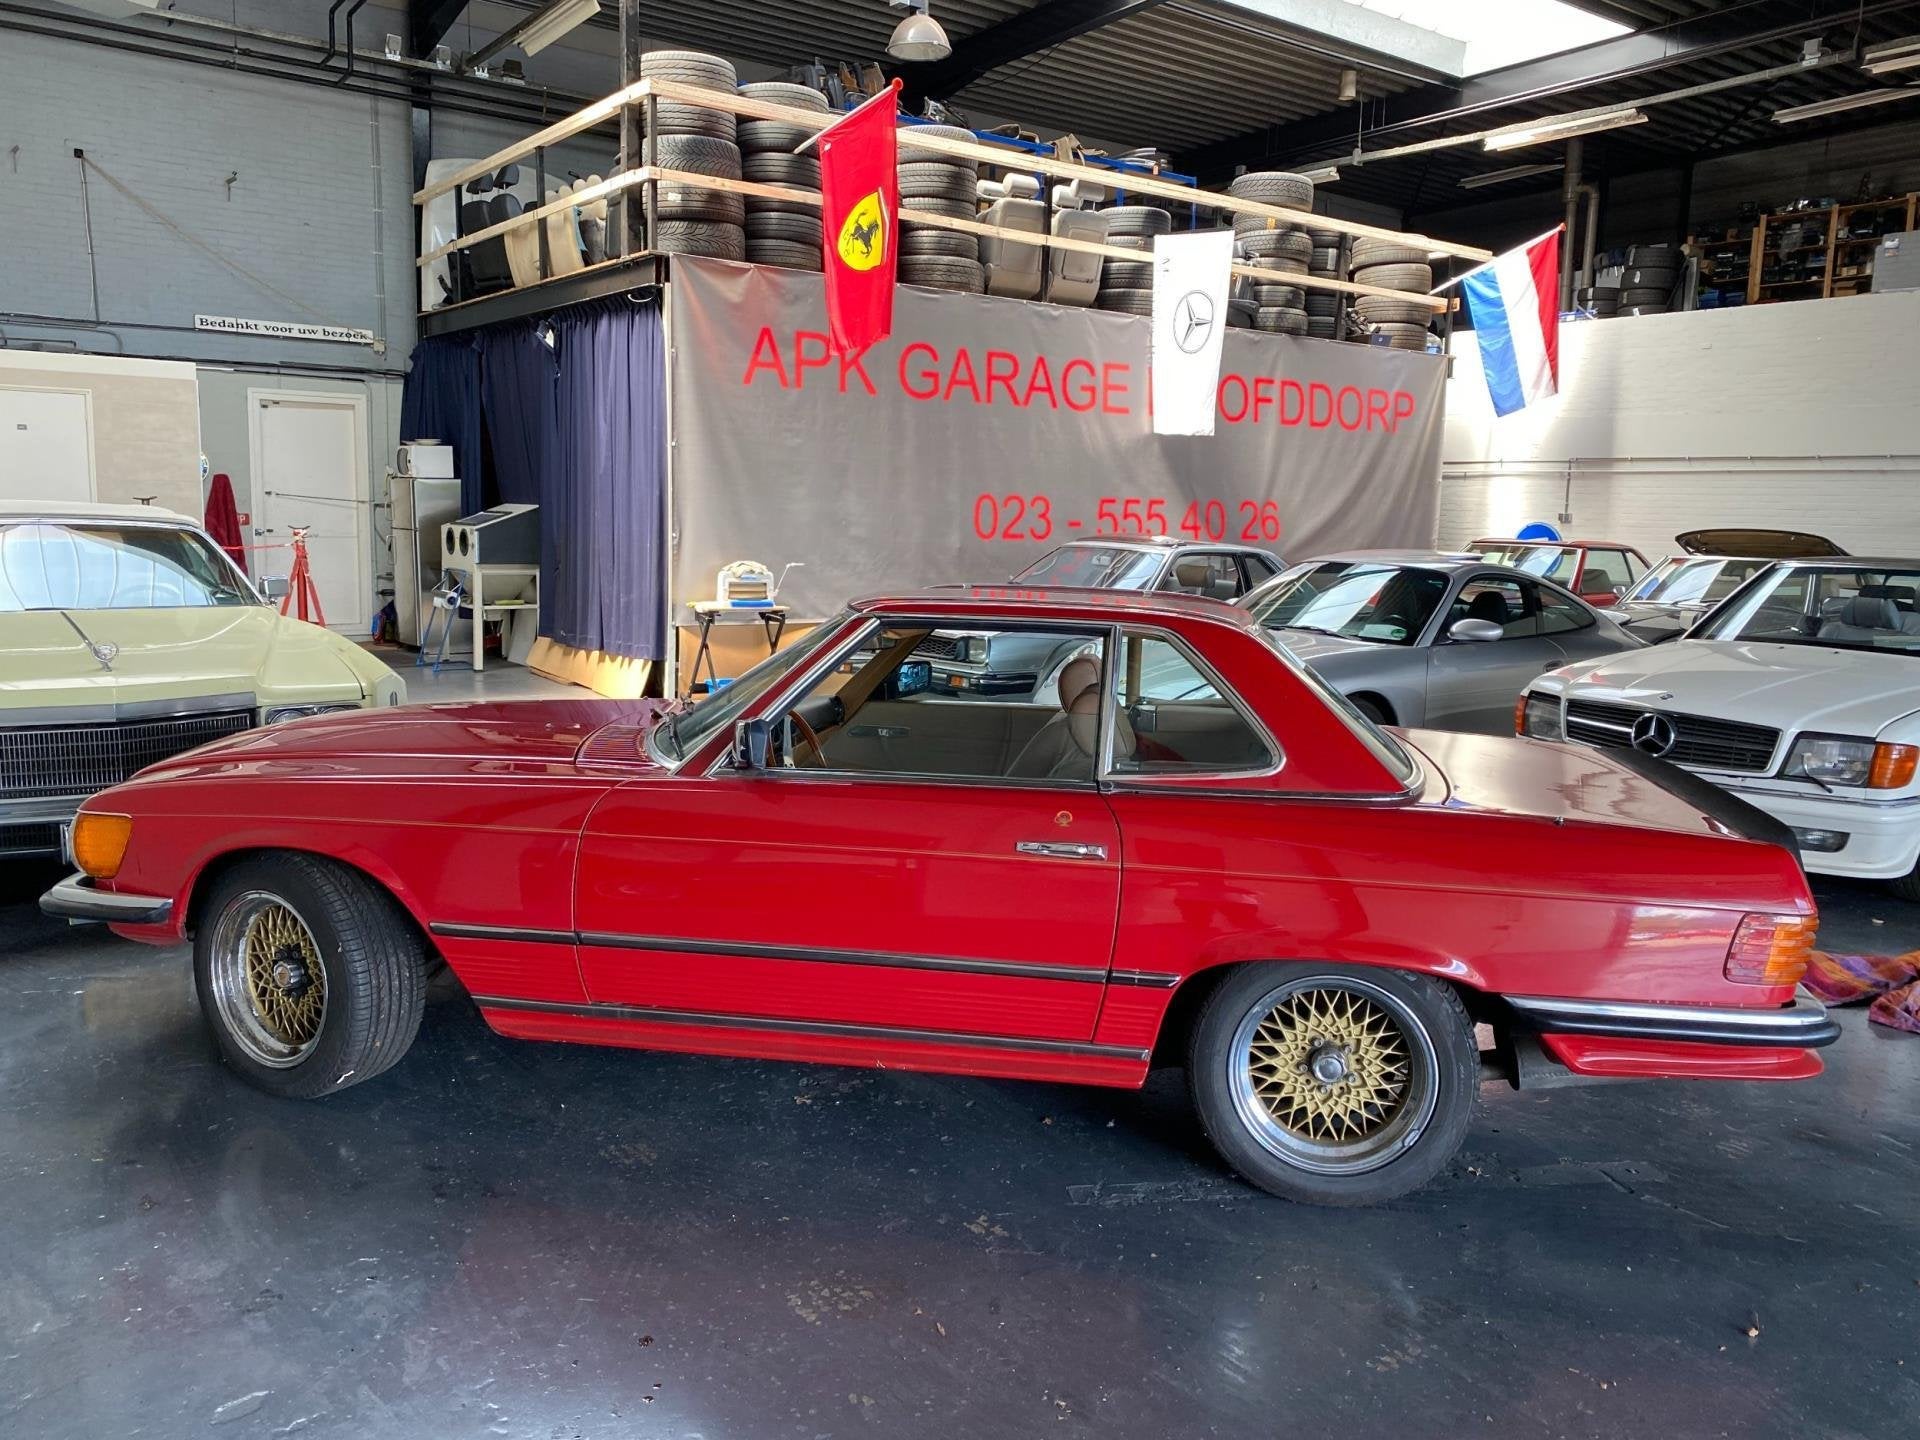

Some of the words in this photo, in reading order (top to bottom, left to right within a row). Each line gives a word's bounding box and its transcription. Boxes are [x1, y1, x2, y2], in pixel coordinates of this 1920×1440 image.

[199, 317, 260, 331] Bedankt
[264, 324, 294, 334] voor
[297, 327, 319, 336] uw
[743, 326, 877, 396] APK
[898, 341, 1131, 415] GARAGE
[973, 493, 1053, 541] 023
[1097, 498, 1168, 536] 555
[1180, 499, 1227, 542] 40
[1240, 499, 1281, 542] 26
